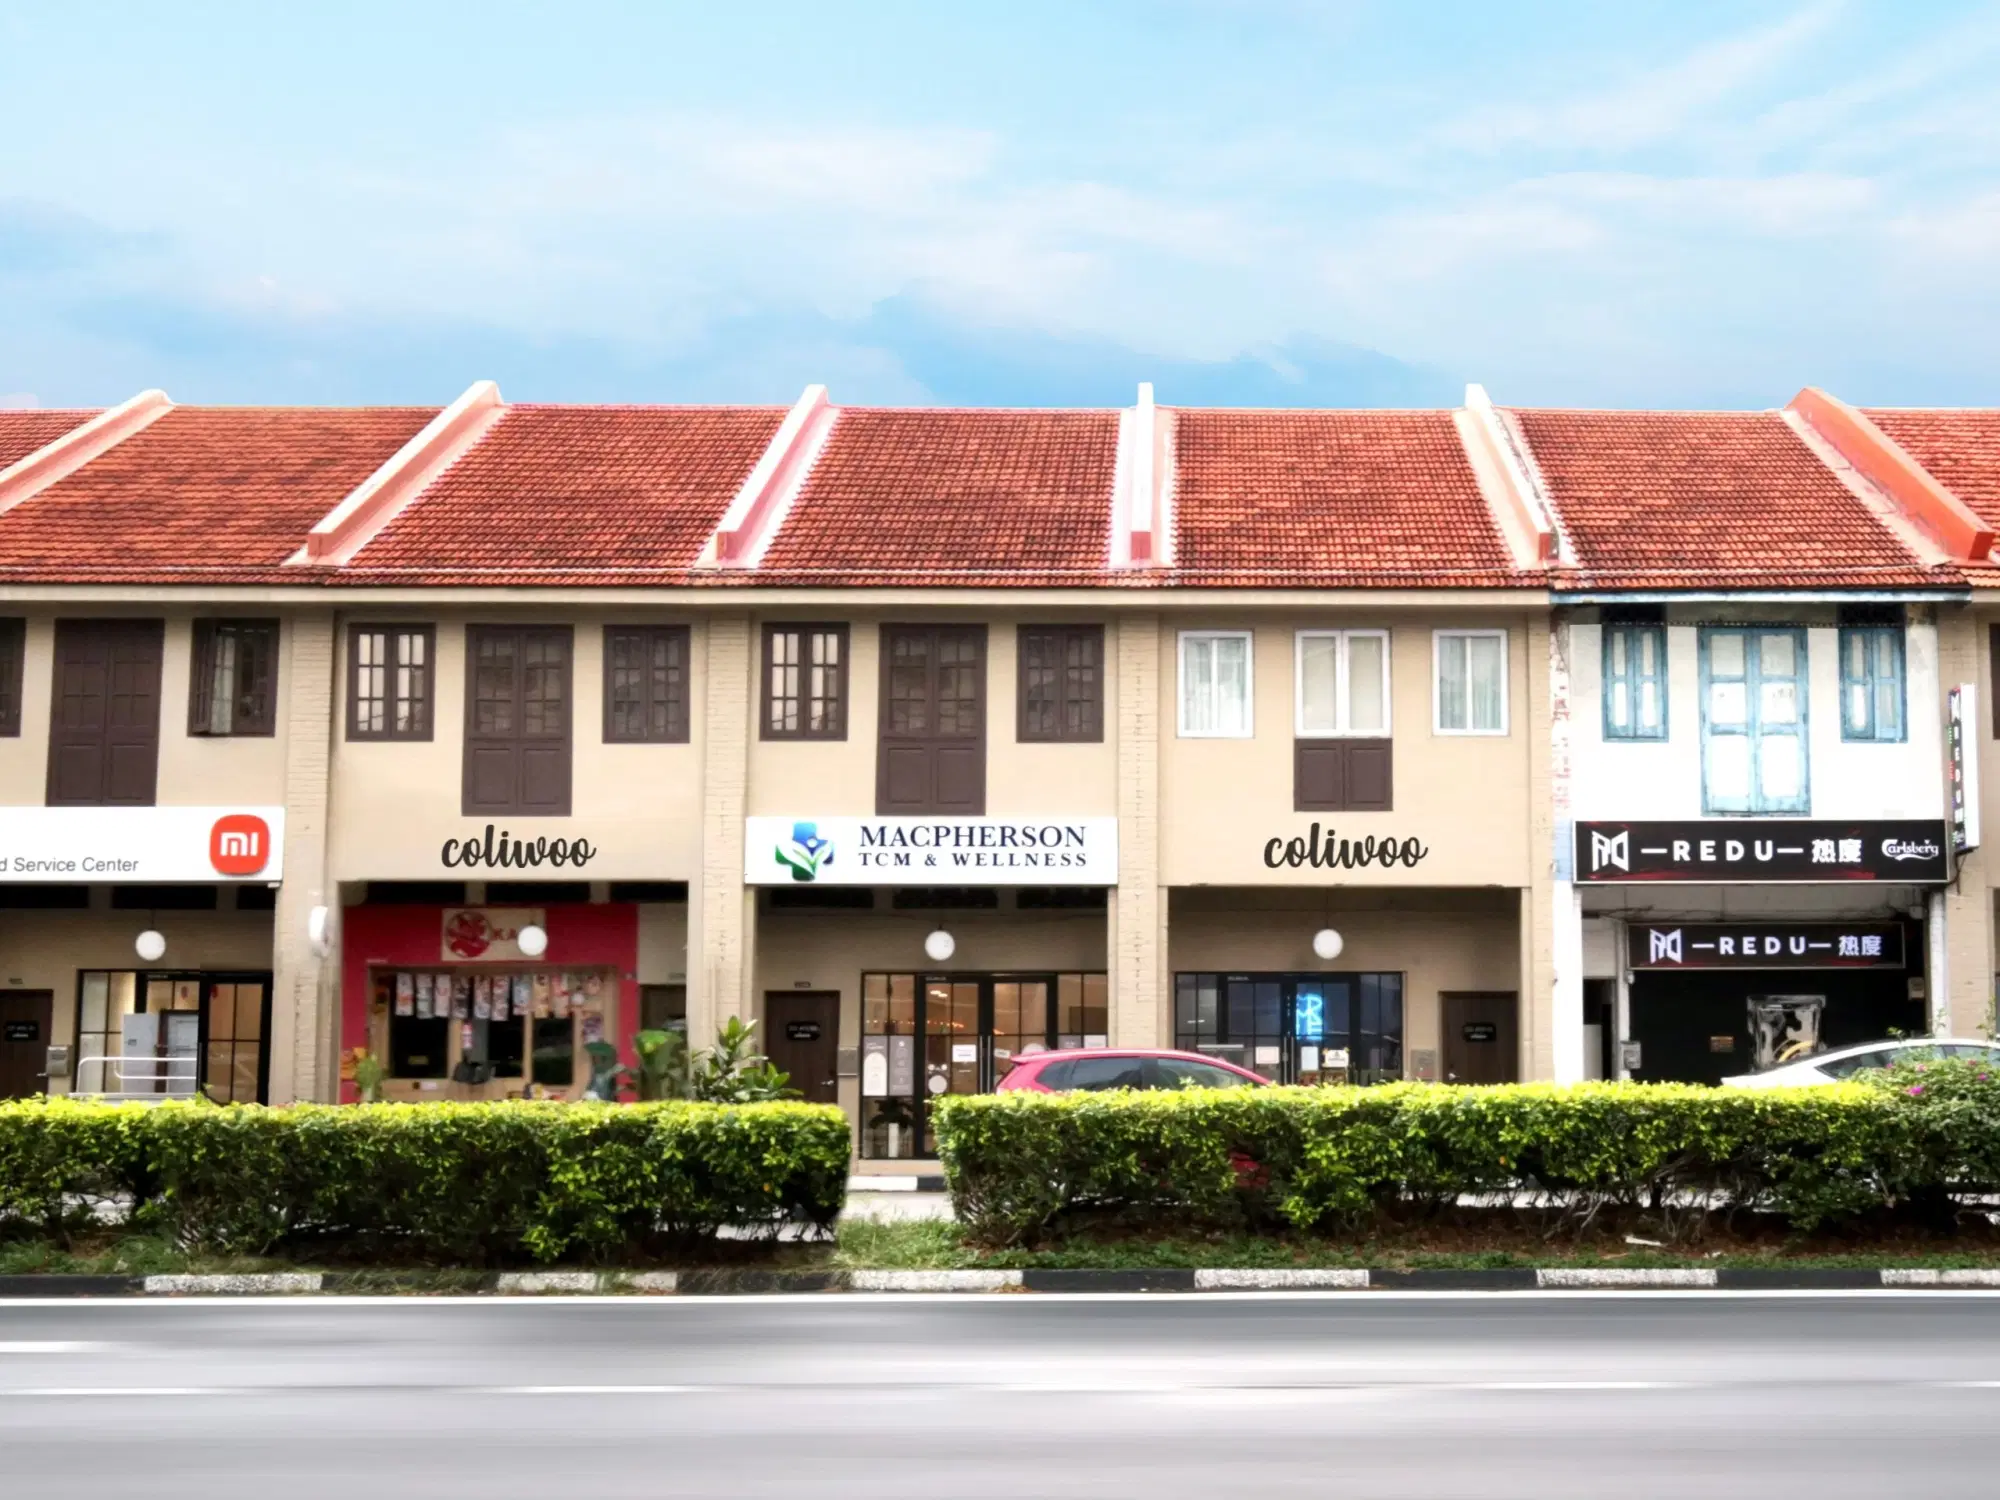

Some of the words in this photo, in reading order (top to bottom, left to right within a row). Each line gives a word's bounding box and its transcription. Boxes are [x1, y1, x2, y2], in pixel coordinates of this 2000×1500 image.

[441, 824, 597, 869] coliwoo
[860, 825, 1087, 848] MACPHERSON
[1263, 822, 1429, 870] coliwoo
[859, 852, 912, 867] TCM
[924, 852, 938, 867] &
[953, 852, 1088, 867] WELLNESS
[1881, 839, 1939, 861] Carlsberg
[13, 857, 77, 872] Service
[82, 857, 139, 872] Center
